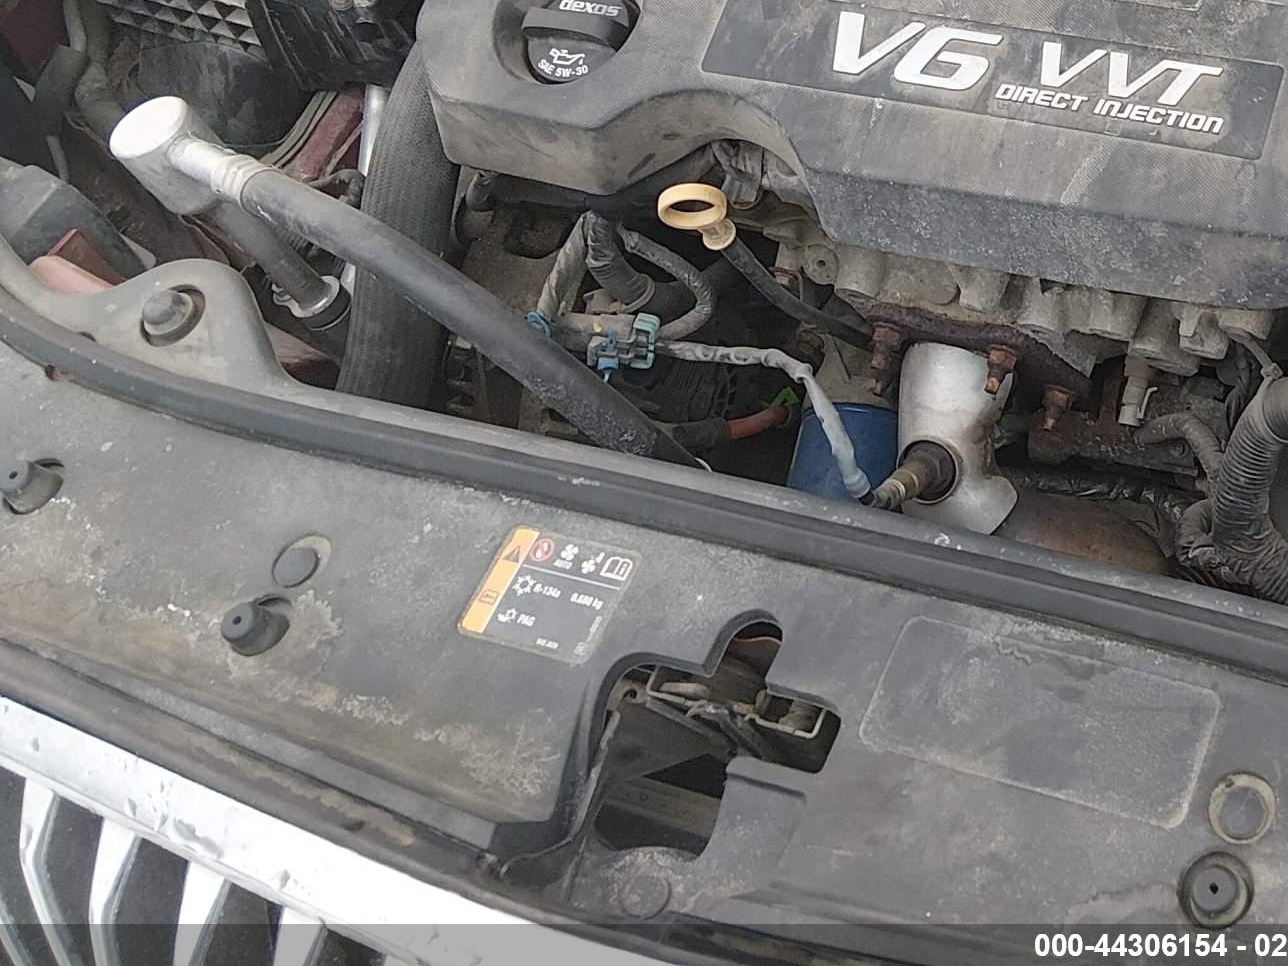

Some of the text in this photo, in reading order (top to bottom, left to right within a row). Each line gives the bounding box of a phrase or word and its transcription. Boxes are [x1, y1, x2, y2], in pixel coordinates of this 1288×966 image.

[538, 59, 589, 78] SAE 5W-30
[832, 11, 1003, 91] V6
[1040, 41, 1223, 106] VVT
[994, 84, 1224, 135] DIRECT INJECTION
[516, 613, 536, 627] PAG
